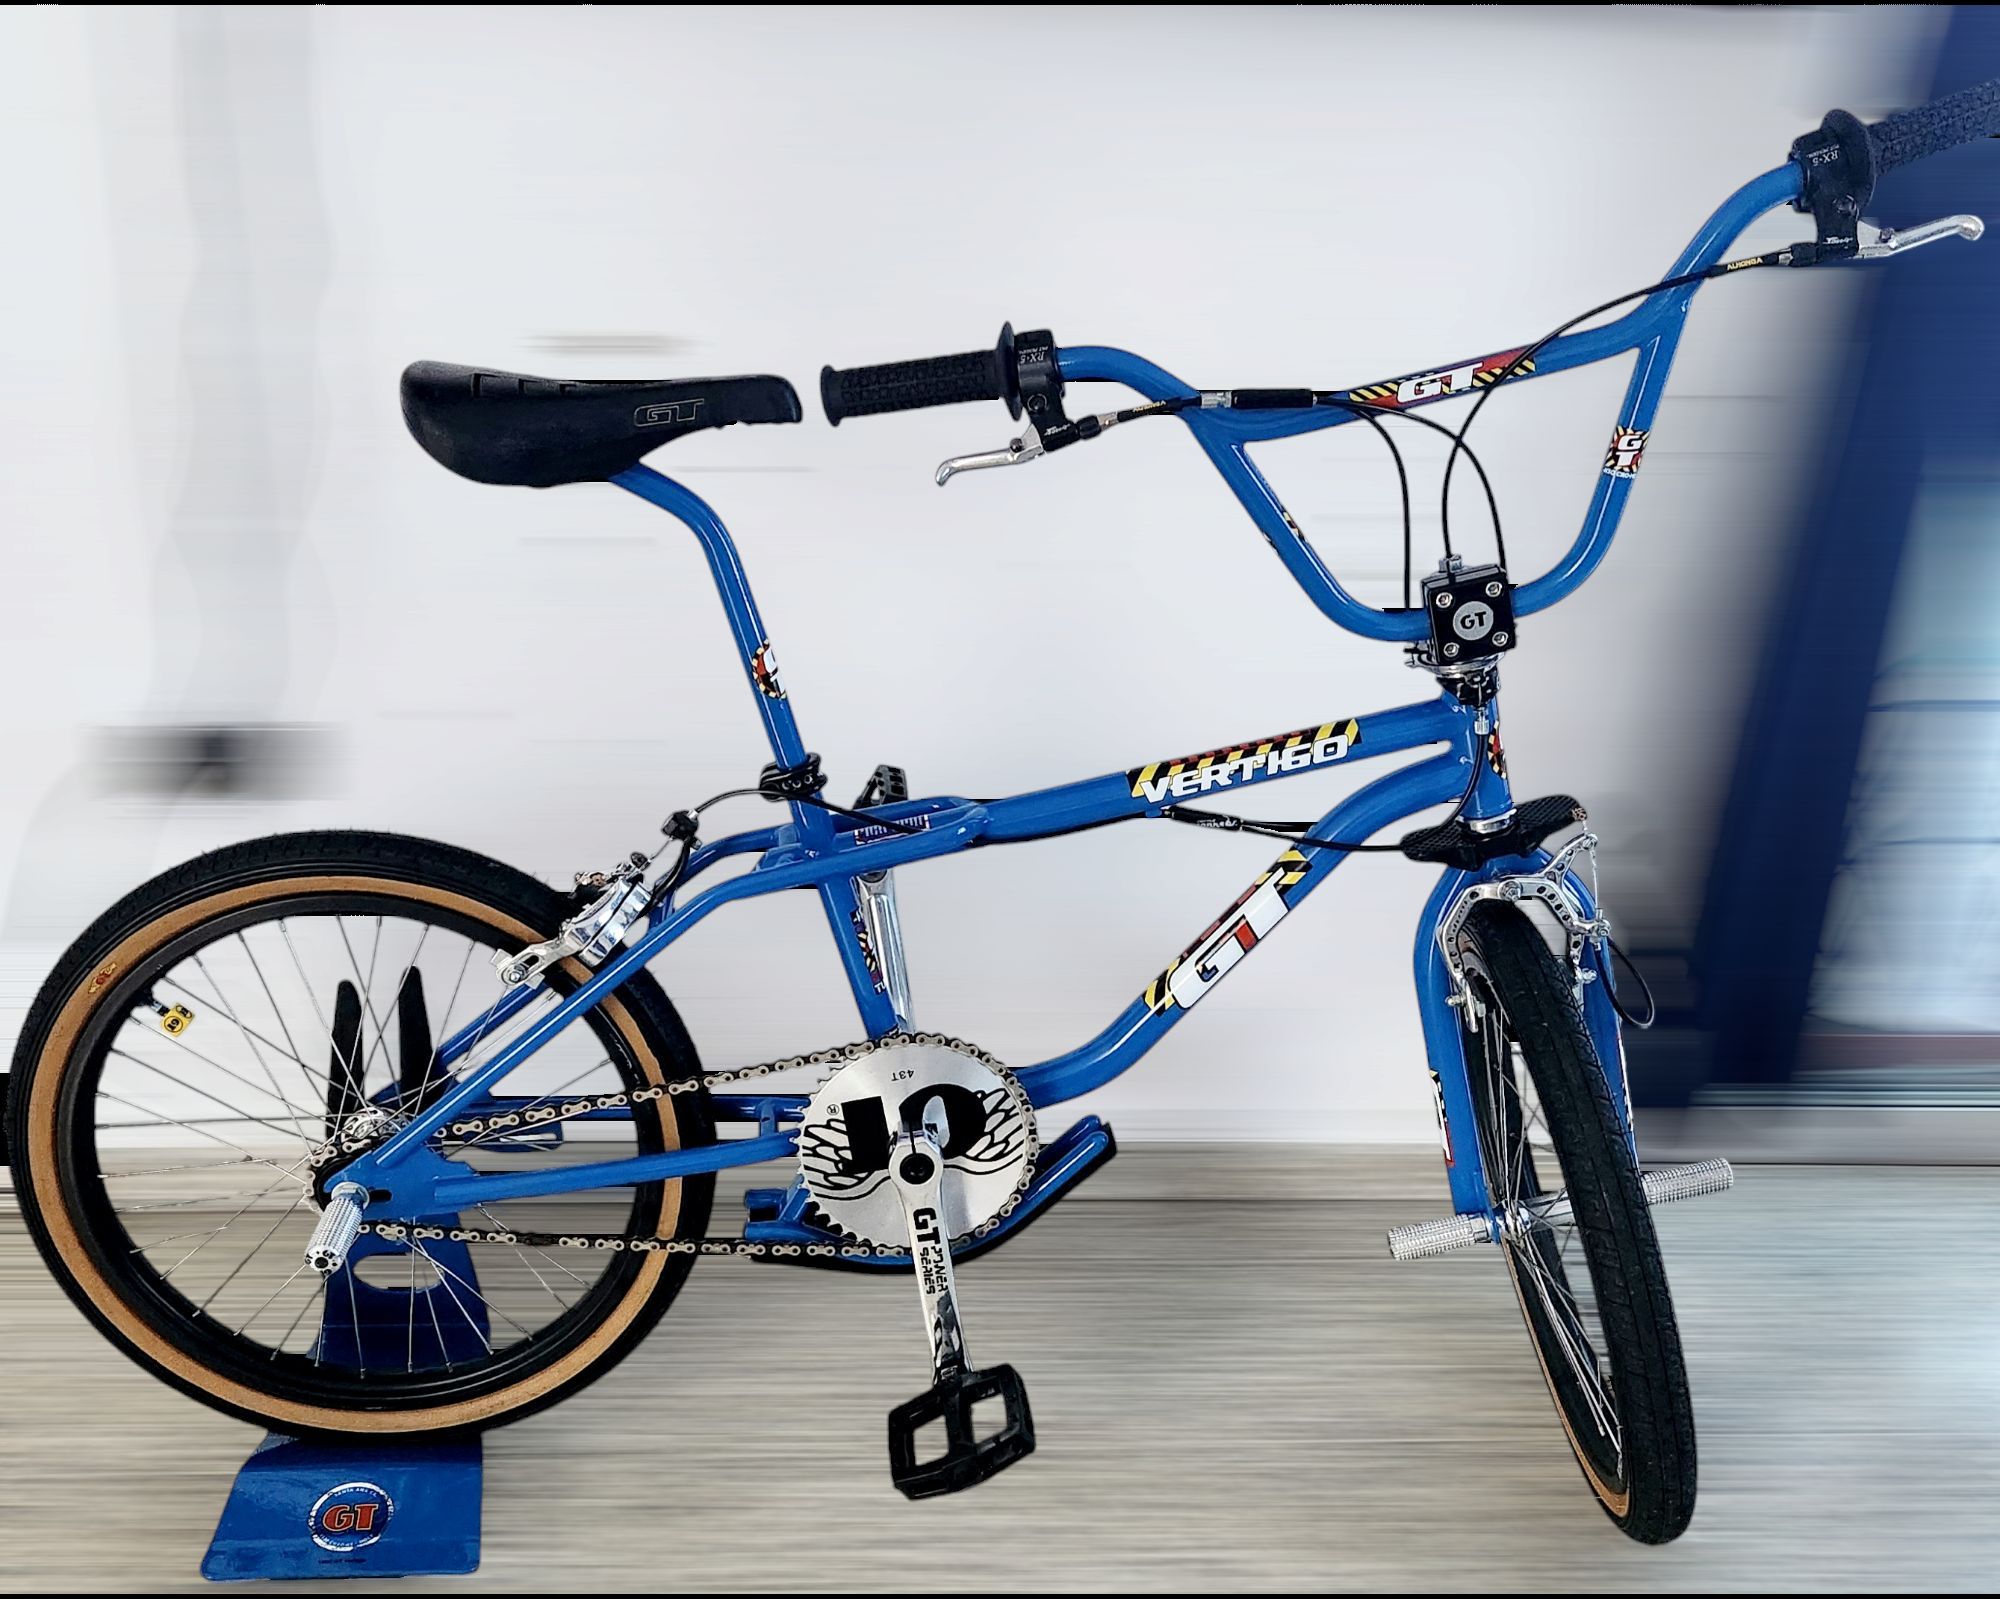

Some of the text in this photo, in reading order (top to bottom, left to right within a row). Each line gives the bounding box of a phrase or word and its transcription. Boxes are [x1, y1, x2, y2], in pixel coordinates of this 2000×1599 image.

[1397, 363, 1483, 403] GT
[633, 398, 705, 427] GT
[1460, 610, 1488, 631] GT
[1139, 734, 1350, 804] VERTIGO
[1168, 866, 1289, 1009] GT
[891, 1070, 915, 1082] 43T
[913, 1207, 941, 1250] GT
[919, 1248, 936, 1295] SERIES
[930, 1245, 949, 1292] POWER
[324, 1505, 379, 1532] GT
